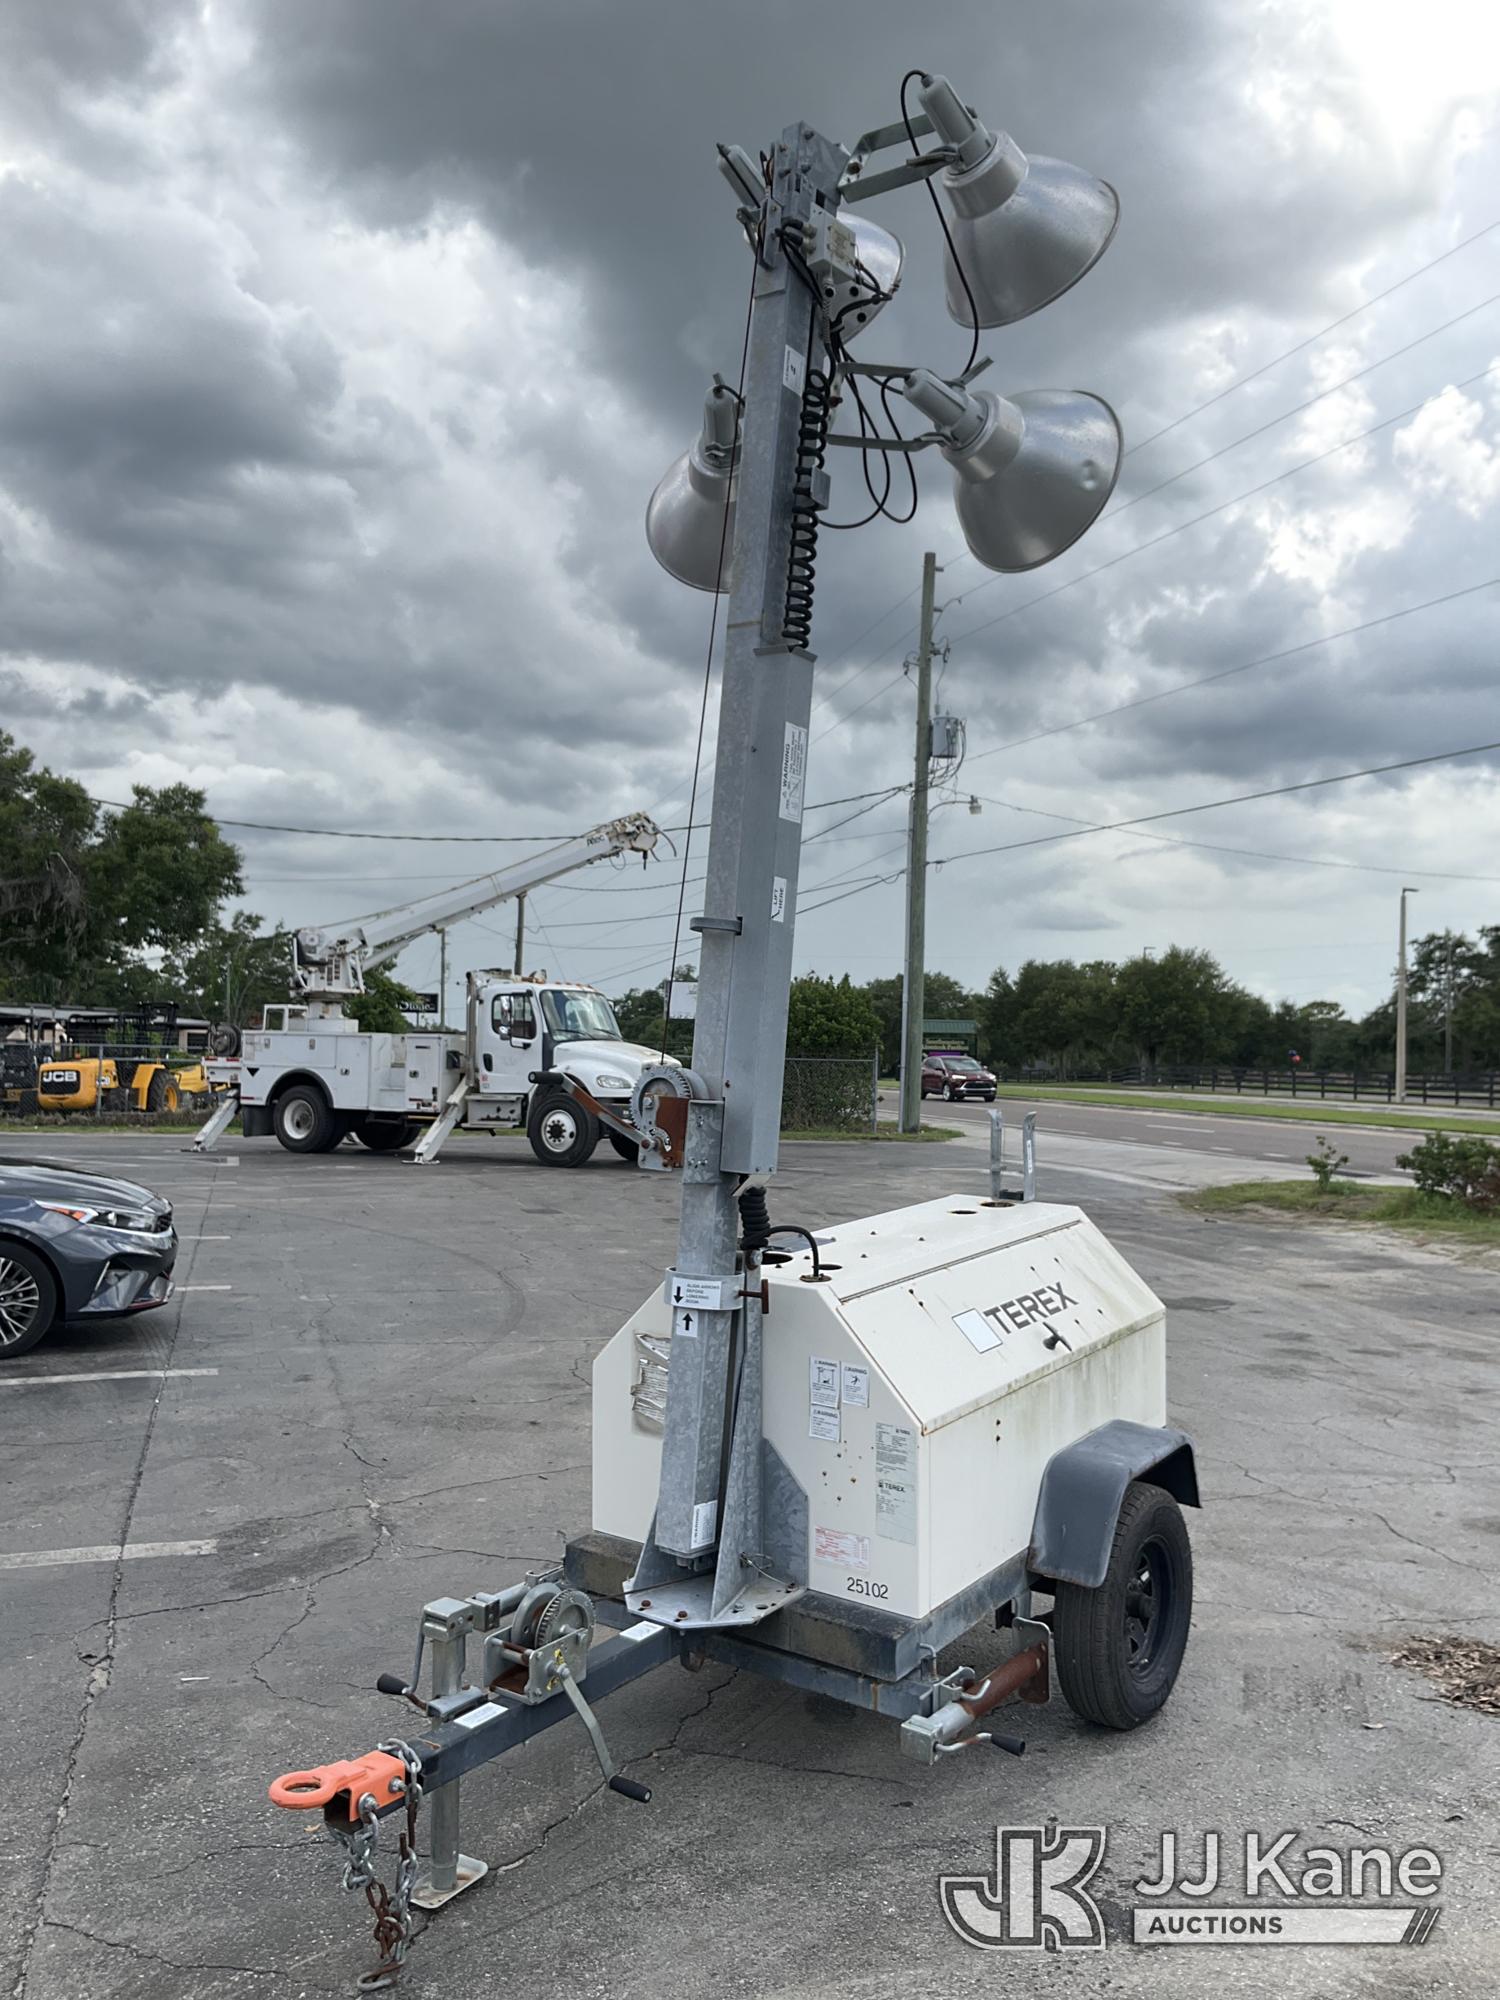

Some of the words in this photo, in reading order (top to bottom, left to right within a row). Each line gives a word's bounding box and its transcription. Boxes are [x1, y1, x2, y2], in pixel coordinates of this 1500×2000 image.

[782, 744, 791, 787] WARNING
[42, 1071, 77, 1083] JCB
[983, 1281, 1079, 1335] TEREX
[884, 1482, 906, 1493] TEREX
[847, 1576, 889, 1600] 25102
